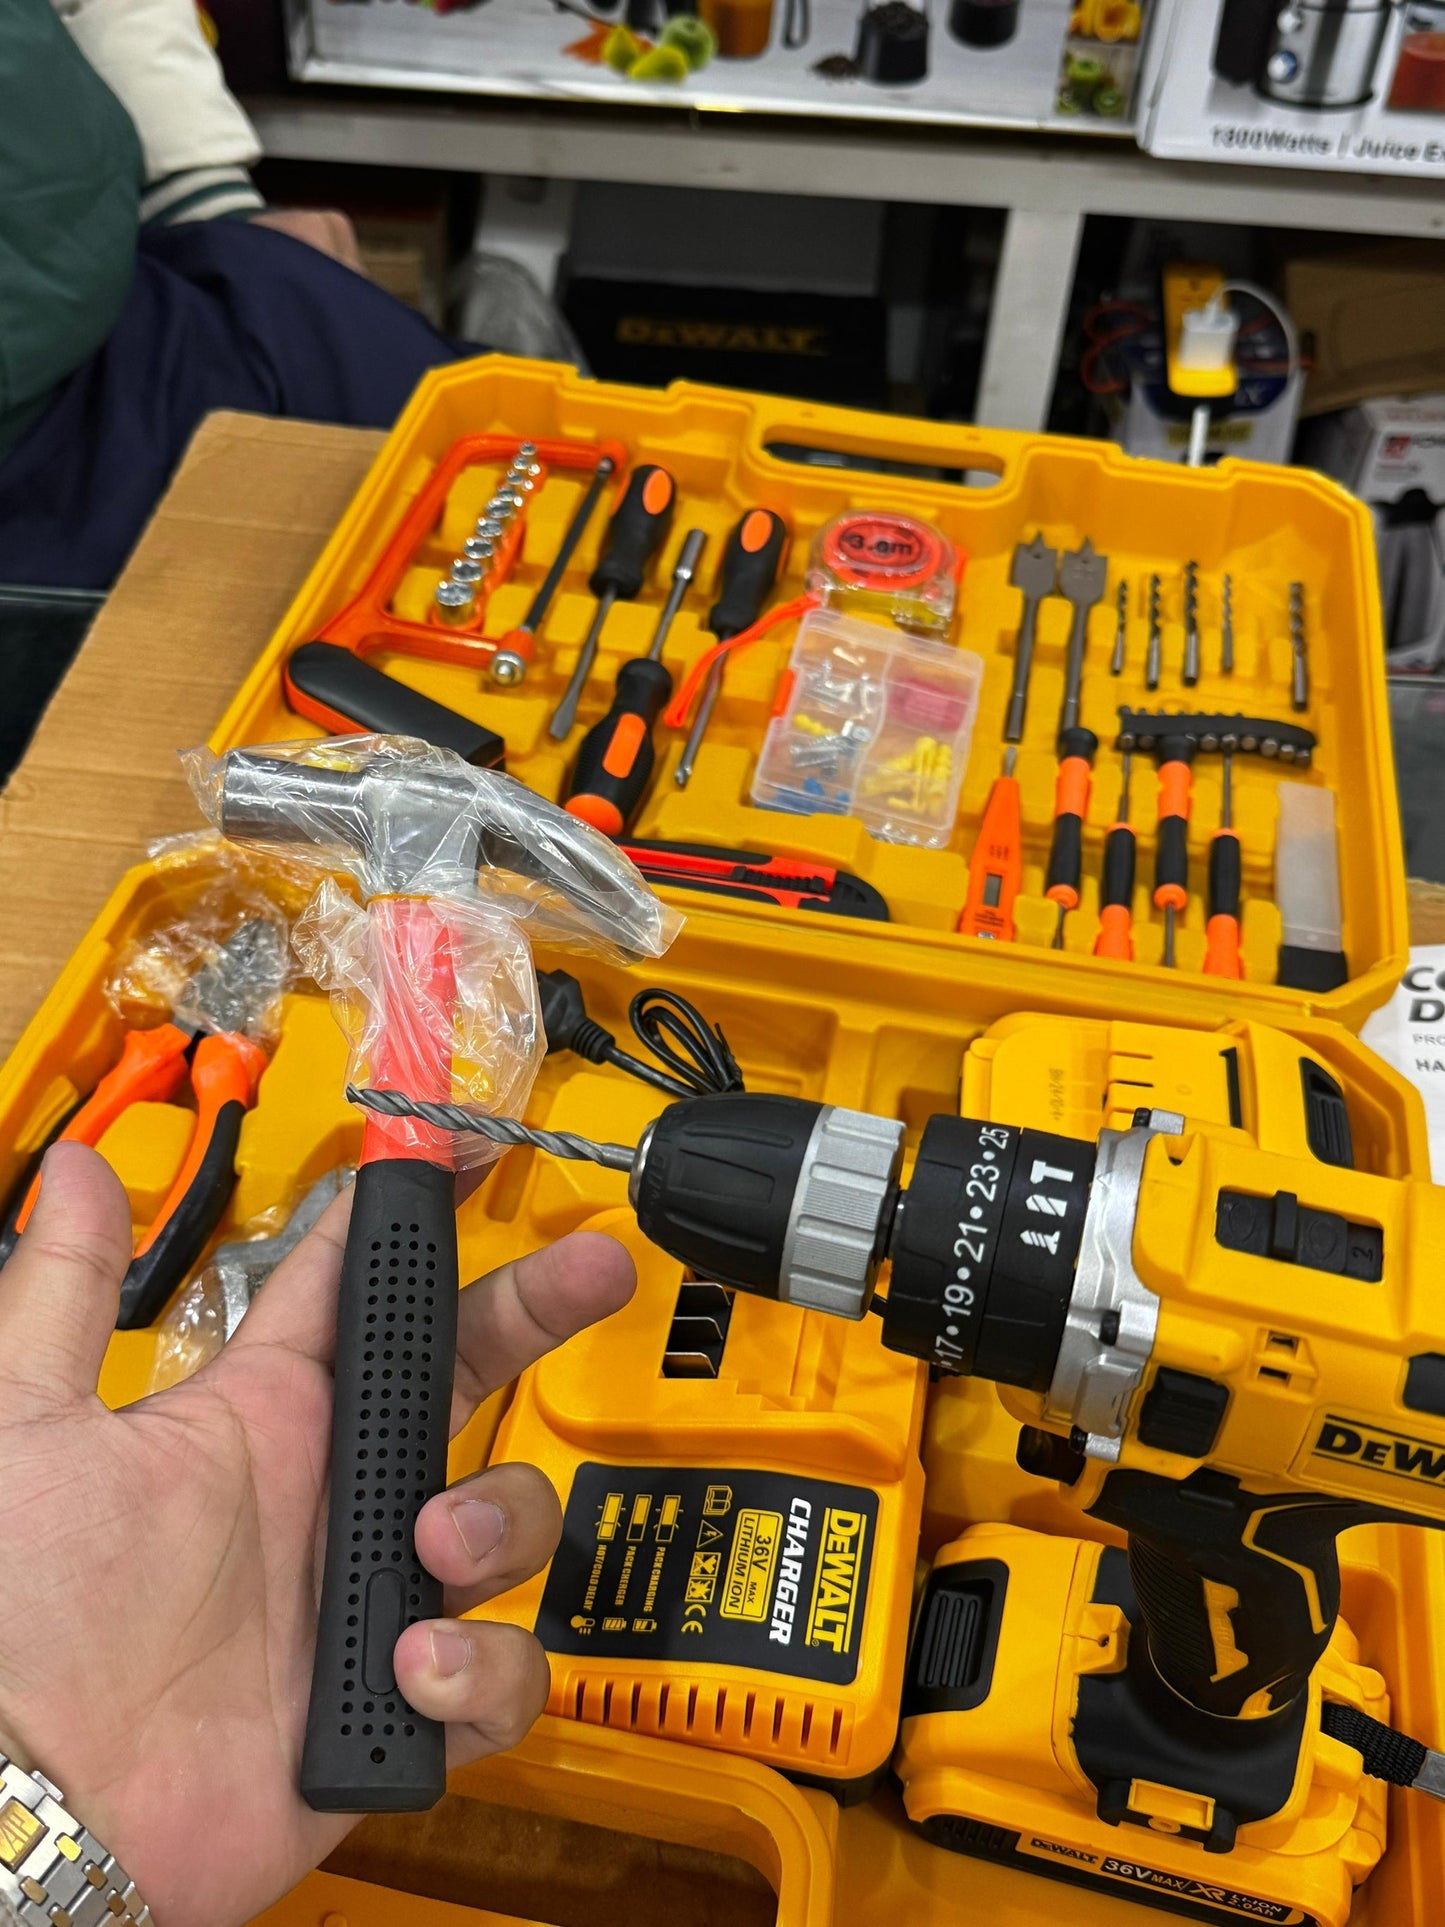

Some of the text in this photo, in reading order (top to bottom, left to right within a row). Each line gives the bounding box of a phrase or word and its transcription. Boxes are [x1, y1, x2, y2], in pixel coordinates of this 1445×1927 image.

[1353, 135, 1419, 161] Juice
[978, 1126, 1010, 1150] 25
[965, 1163, 1001, 1203] 23
[953, 1221, 989, 1264] 21
[941, 1284, 975, 1316] 19
[1315, 1421, 1445, 1482] DEW
[623, 1545, 637, 1568] PACK
[729, 1516, 755, 1609] LITHIUM ION
[748, 1535, 772, 1604] 36V MAX
[769, 1497, 812, 1645] CHARGER
[583, 1585, 598, 1611] DELAY
[643, 1546, 666, 1613] PACK CHARGING
[812, 1508, 861, 1654] DEWALT
[1031, 1838, 1099, 1864] DEWALT
[1105, 1859, 1152, 1880] 36V
[1190, 1882, 1227, 1902] XR
